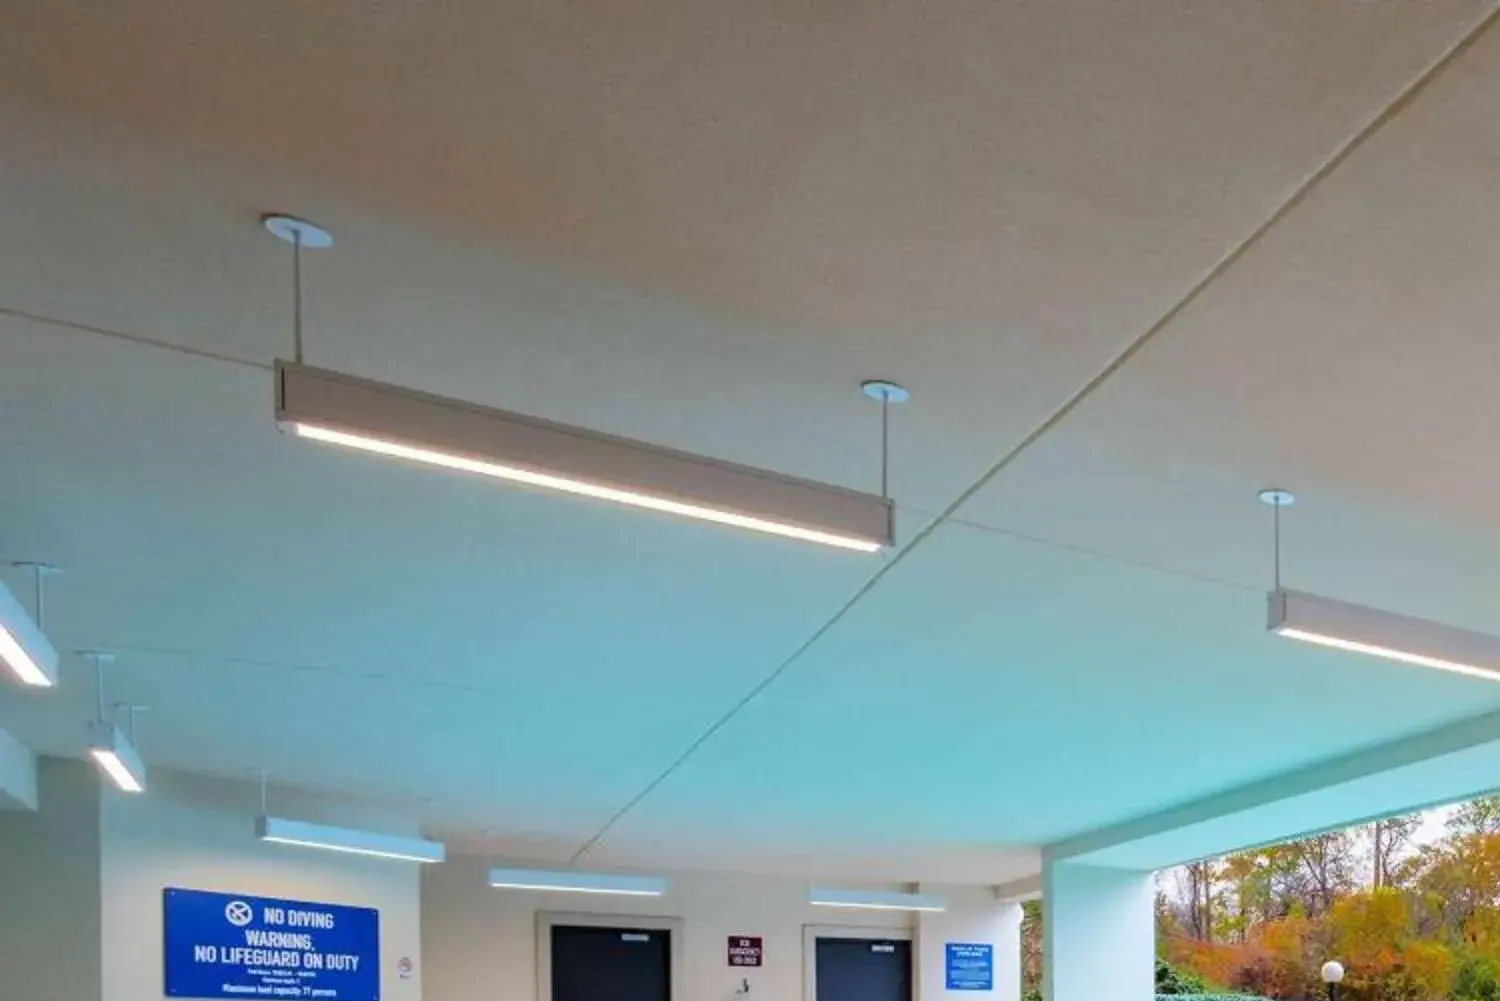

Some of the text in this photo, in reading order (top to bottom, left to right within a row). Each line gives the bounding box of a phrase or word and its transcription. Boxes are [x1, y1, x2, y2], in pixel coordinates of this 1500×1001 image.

[263, 907, 335, 929] NO DIVING
[194, 945, 359, 972] NO LIFEGUARD ON DUTY
